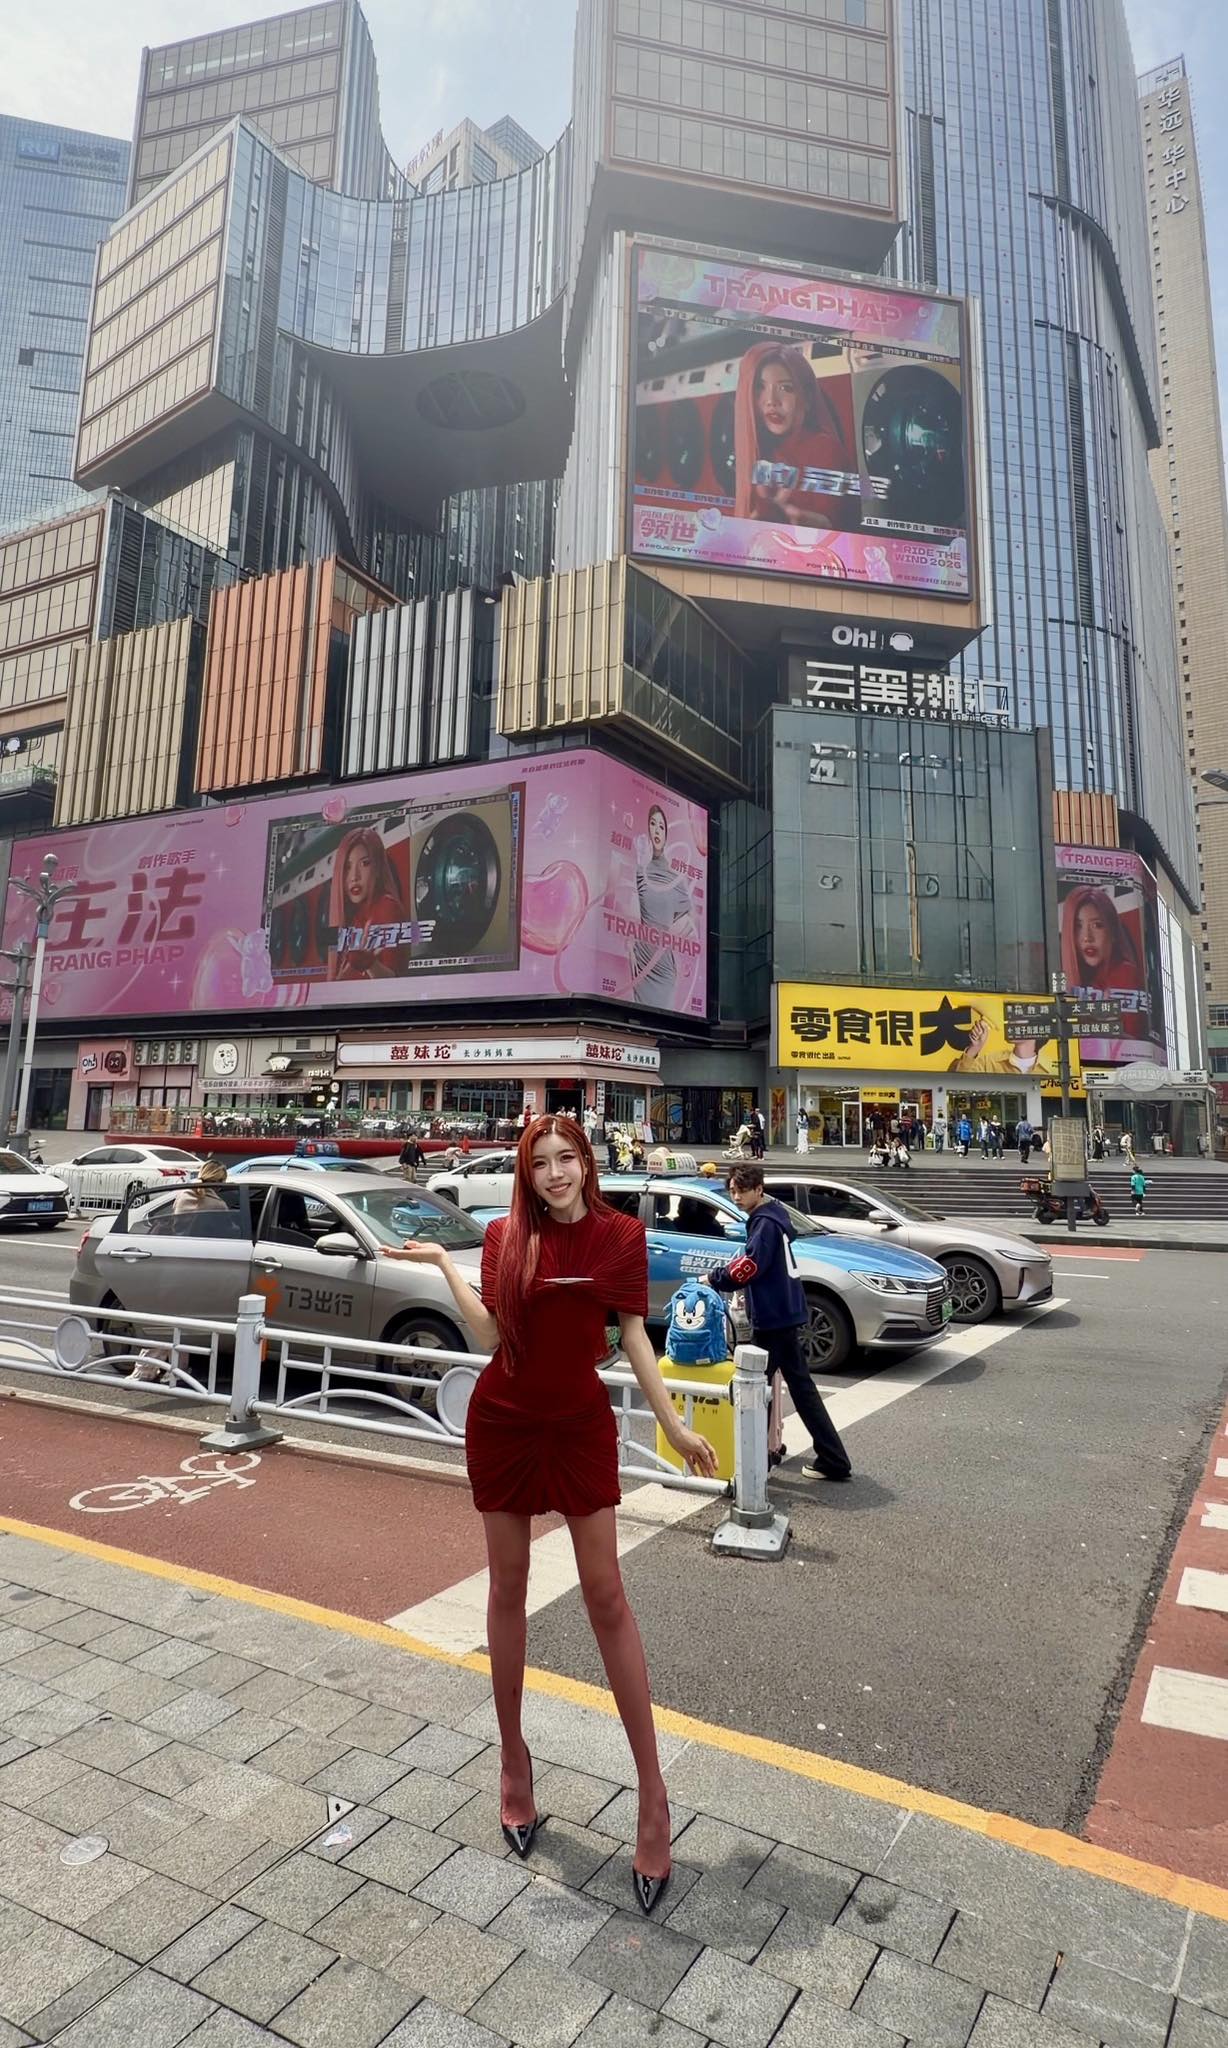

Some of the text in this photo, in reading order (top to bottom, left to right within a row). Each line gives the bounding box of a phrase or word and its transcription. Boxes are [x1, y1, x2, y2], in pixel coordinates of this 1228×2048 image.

[1157, 86, 1190, 214] 华远·华中心
[704, 274, 812, 311] TRANG
[817, 291, 902, 325] PHAP
[895, 553, 928, 565] WIND
[903, 545, 962, 561] RIDE THE
[831, 625, 877, 649] Oh!
[1064, 852, 1114, 868] TRANG
[603, 912, 702, 958] TRANG PHAP
[115, 944, 185, 967] PHAP
[1071, 1002, 1111, 1013] 太平街
[82, 1053, 97, 1068] Oh!
[284, 1284, 354, 1317] T3出行
